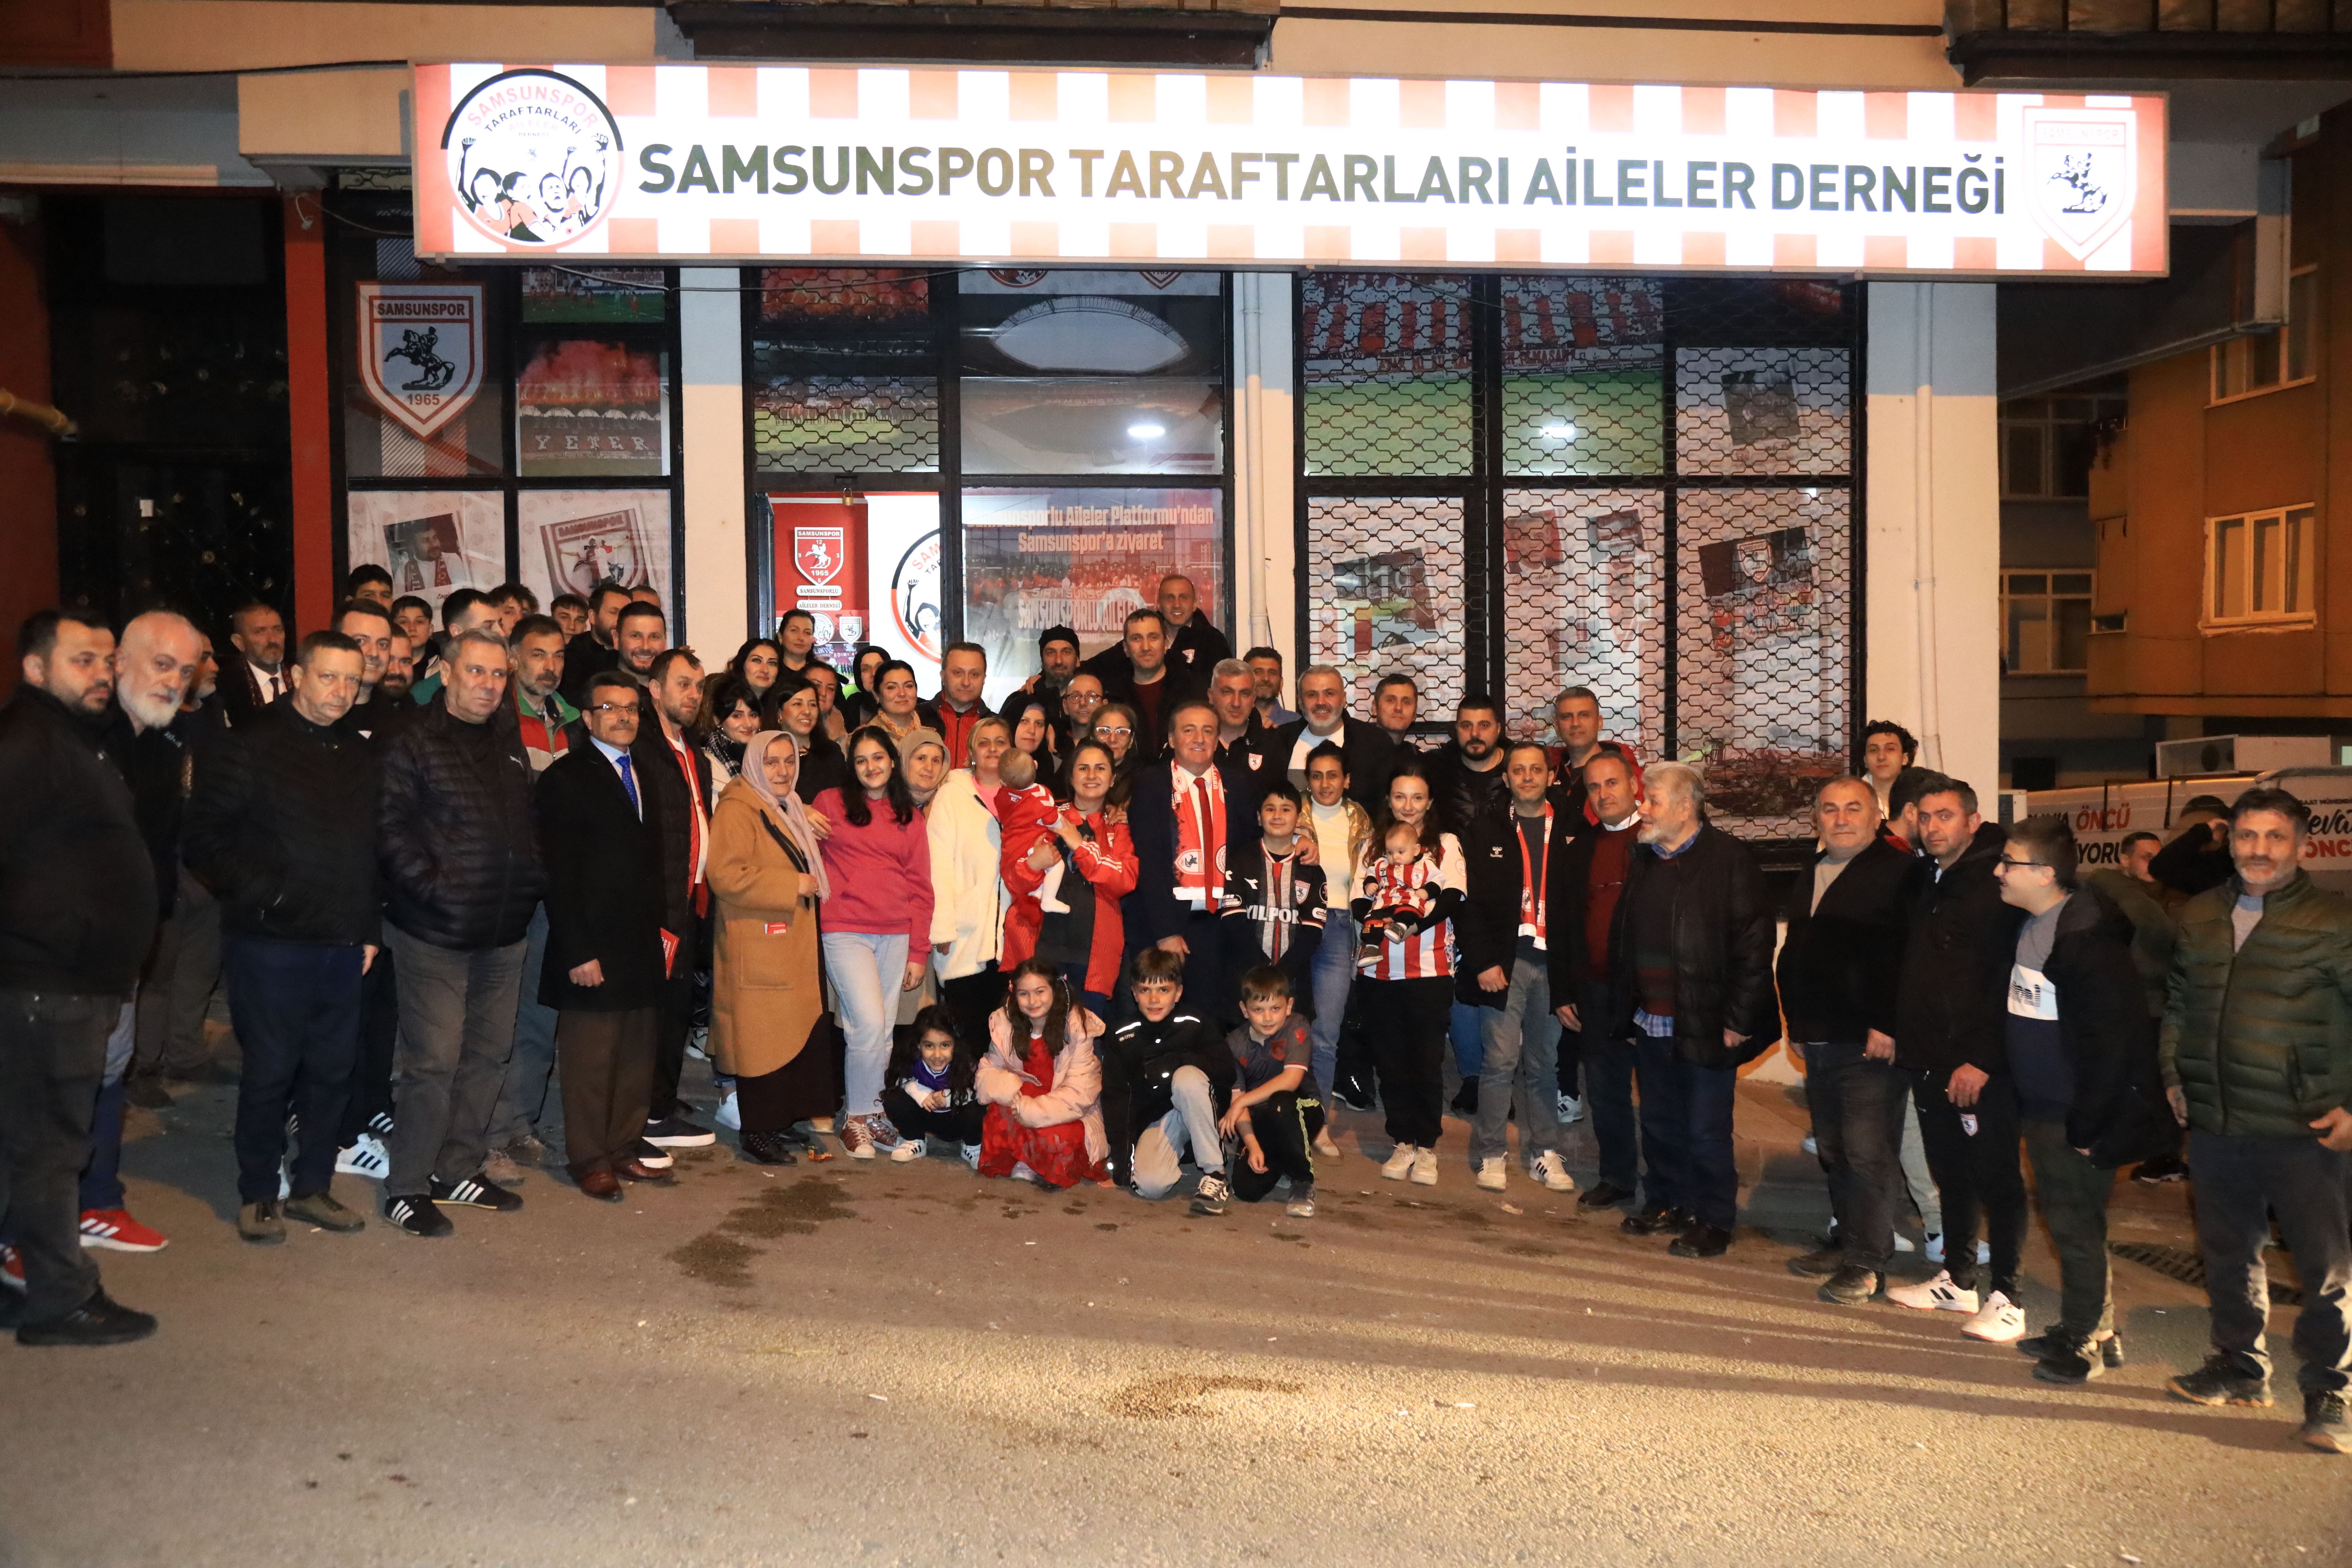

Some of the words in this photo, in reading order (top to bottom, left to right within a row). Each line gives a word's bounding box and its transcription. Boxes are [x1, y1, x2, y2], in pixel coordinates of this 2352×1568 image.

[467, 86, 599, 129] SAMSUNSPOR
[484, 106, 582, 135] TARAFTARLARI
[2042, 128, 2119, 140] SAMSUNSPOR
[639, 144, 1057, 197] SAMSUNSPOR
[1069, 149, 1509, 205] TARAFTARLARI
[1523, 146, 1756, 209] AİLELER
[1772, 153, 2004, 214] DERNEĞİ
[378, 303, 465, 315] SAMSUNSPOR
[407, 394, 440, 406] 1965
[1066, 505, 1109, 527] Aileler
[1111, 504, 1214, 528] Platformu'ndan
[1018, 531, 1114, 554] Samsunspor'a
[1116, 530, 1164, 554] ziyaret
[2305, 836, 2352, 859] ÖNC
[1246, 905, 1300, 924] YILPOR
